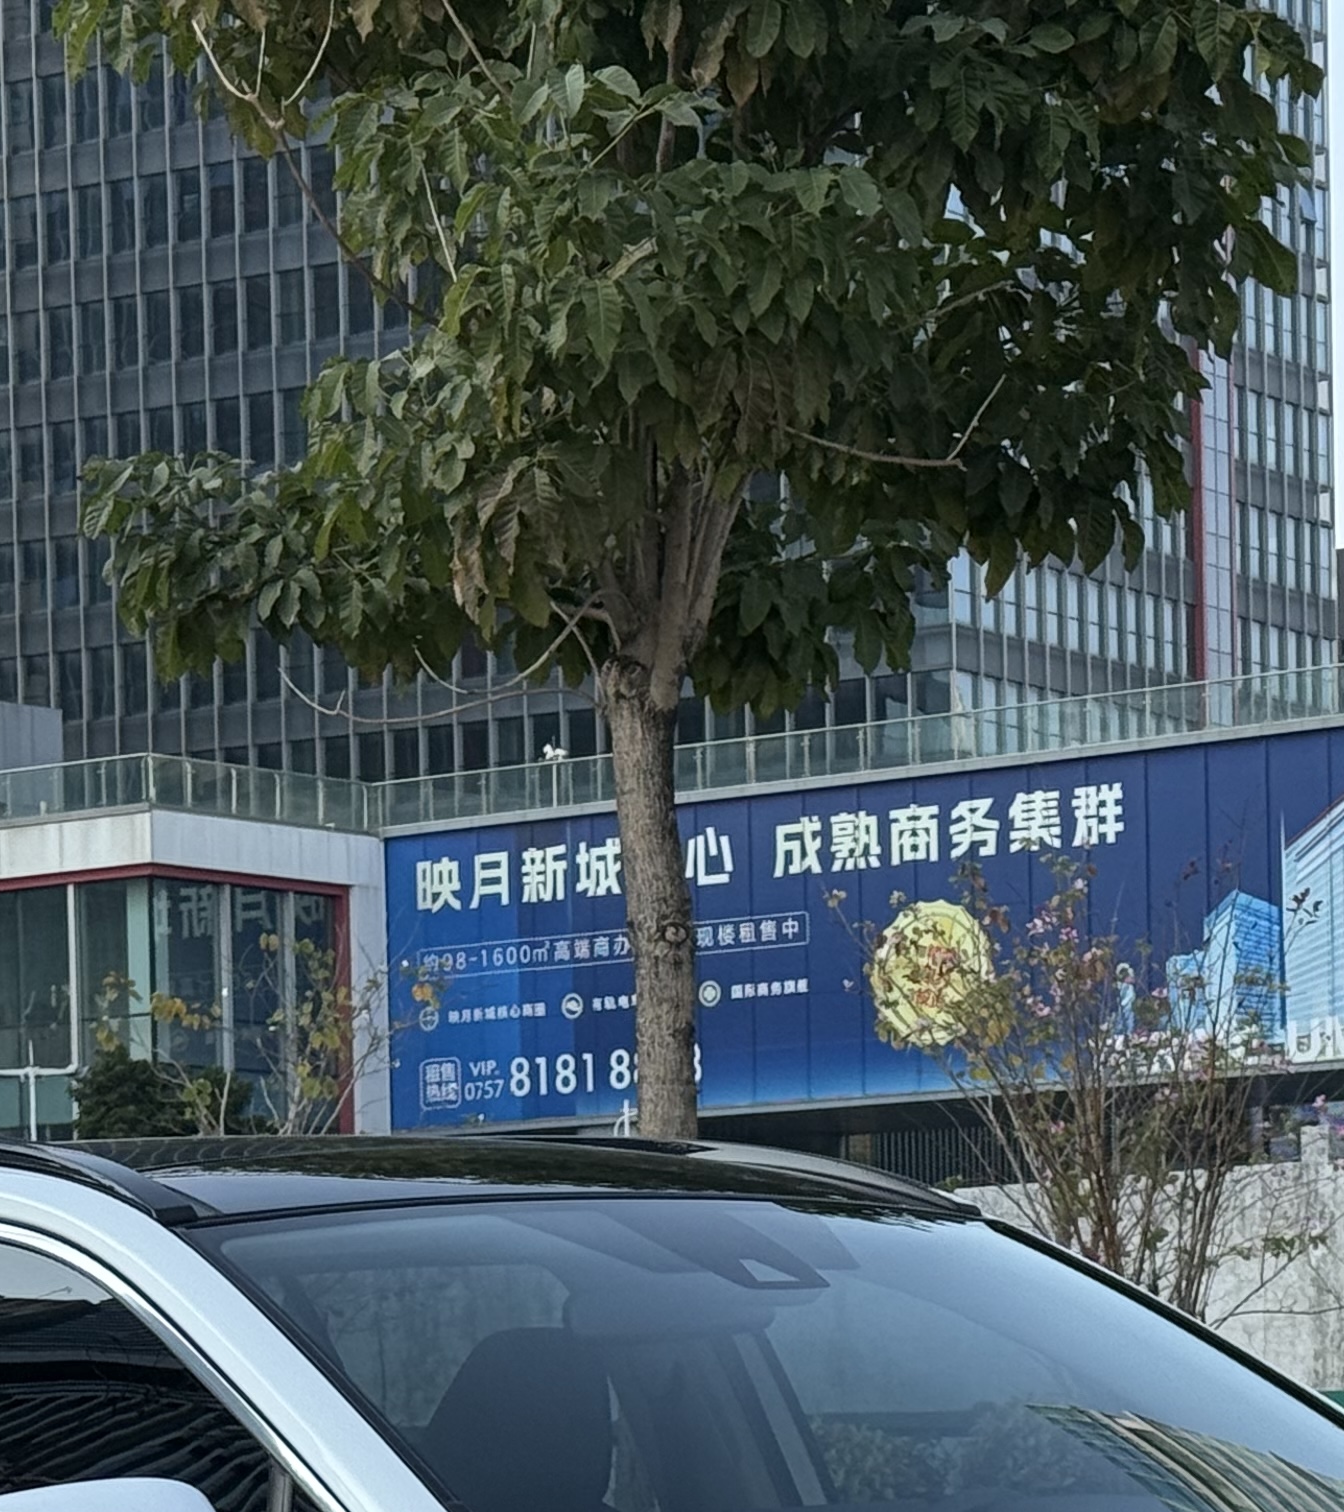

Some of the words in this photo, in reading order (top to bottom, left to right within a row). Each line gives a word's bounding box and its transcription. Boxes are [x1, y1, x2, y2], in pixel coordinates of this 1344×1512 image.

[415, 825, 735, 913] 映月新城心
[772, 782, 1125, 878] 成熟商务集群
[464, 1078, 505, 1102] 0757
[510, 1053, 595, 1097] 8181
